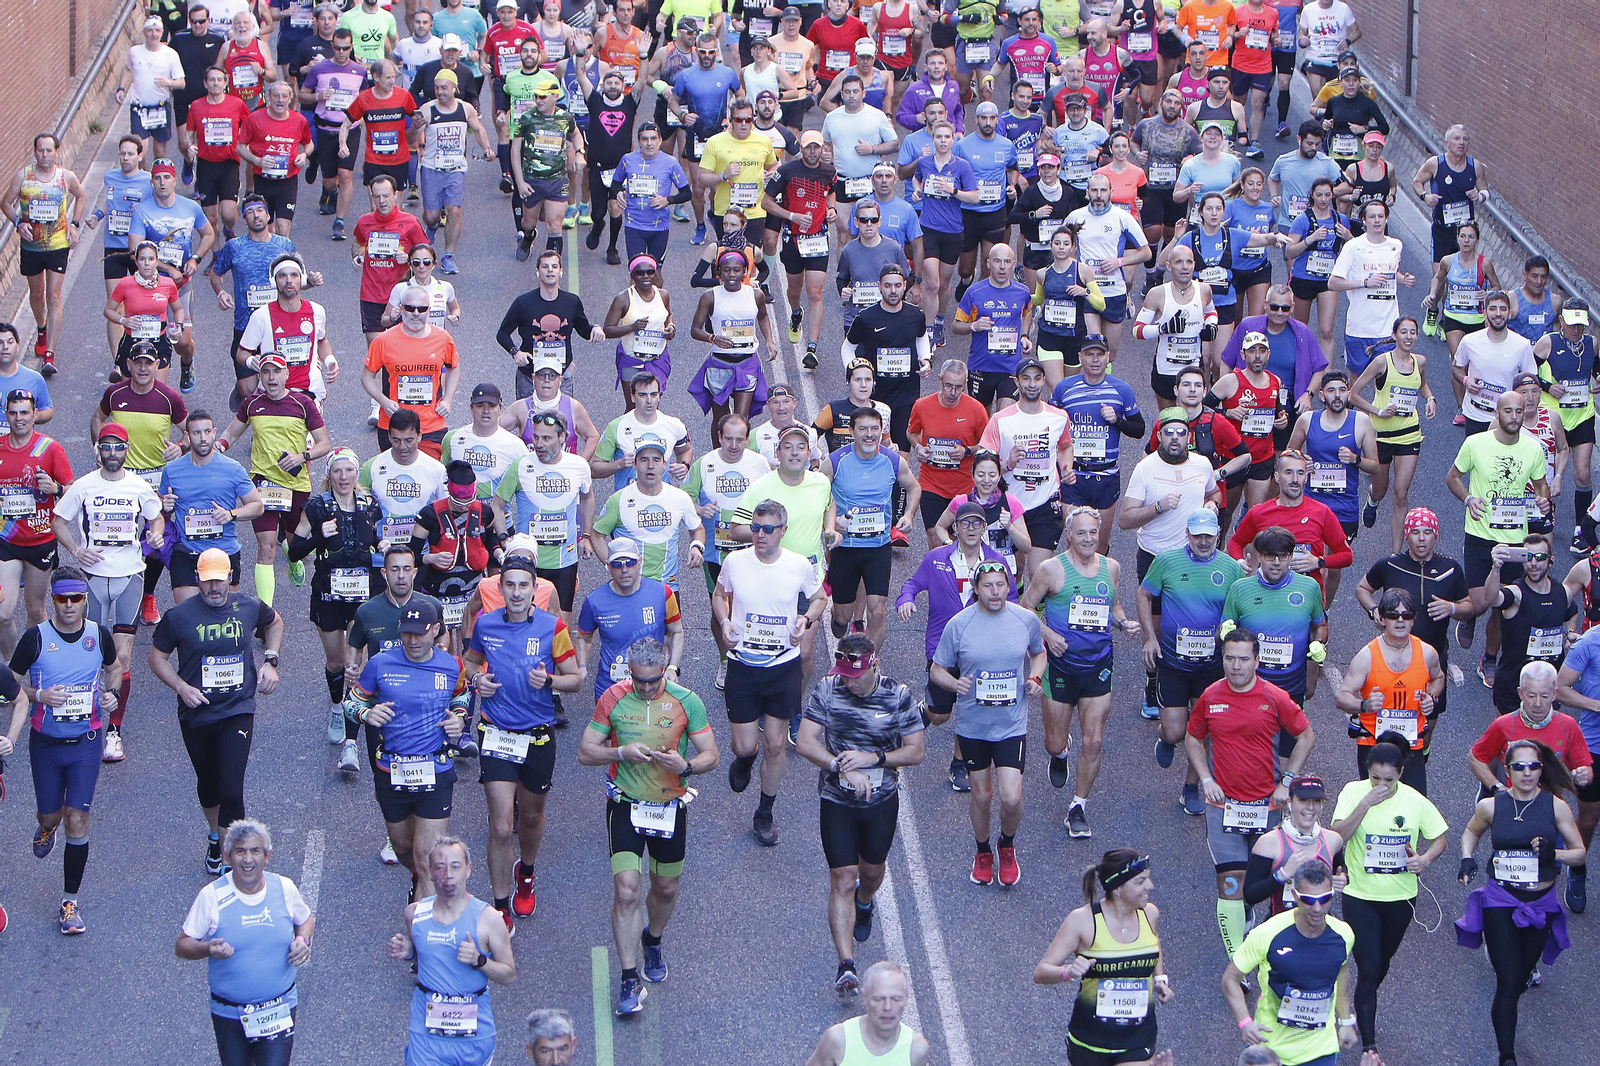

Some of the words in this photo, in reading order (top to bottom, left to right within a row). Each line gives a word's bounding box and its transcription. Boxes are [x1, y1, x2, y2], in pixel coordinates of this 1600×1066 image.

[372, 113, 402, 121] Santander
[437, 127, 460, 136] RUN
[437, 140, 460, 149] NING
[395, 364, 439, 372] SQUIRREL
[1485, 383, 1505, 393] ZURICH
[1074, 413, 1092, 424] Club
[1071, 424, 1109, 433] Running
[93, 497, 132, 507] WIDEX
[106, 513, 129, 521] ZURICH
[643, 610, 655, 624] 091
[526, 642, 540, 656] 091
[435, 676, 448, 690] 091
[499, 736, 516, 744] 9099
[644, 812, 664, 820] 11686
[1116, 982, 1142, 990] ZURICH
[443, 995, 472, 1003] ZURICH
[1302, 991, 1327, 999] ZURICH
[256, 1012, 278, 1024] 12977
[260, 1025, 280, 1035] ANGELO
